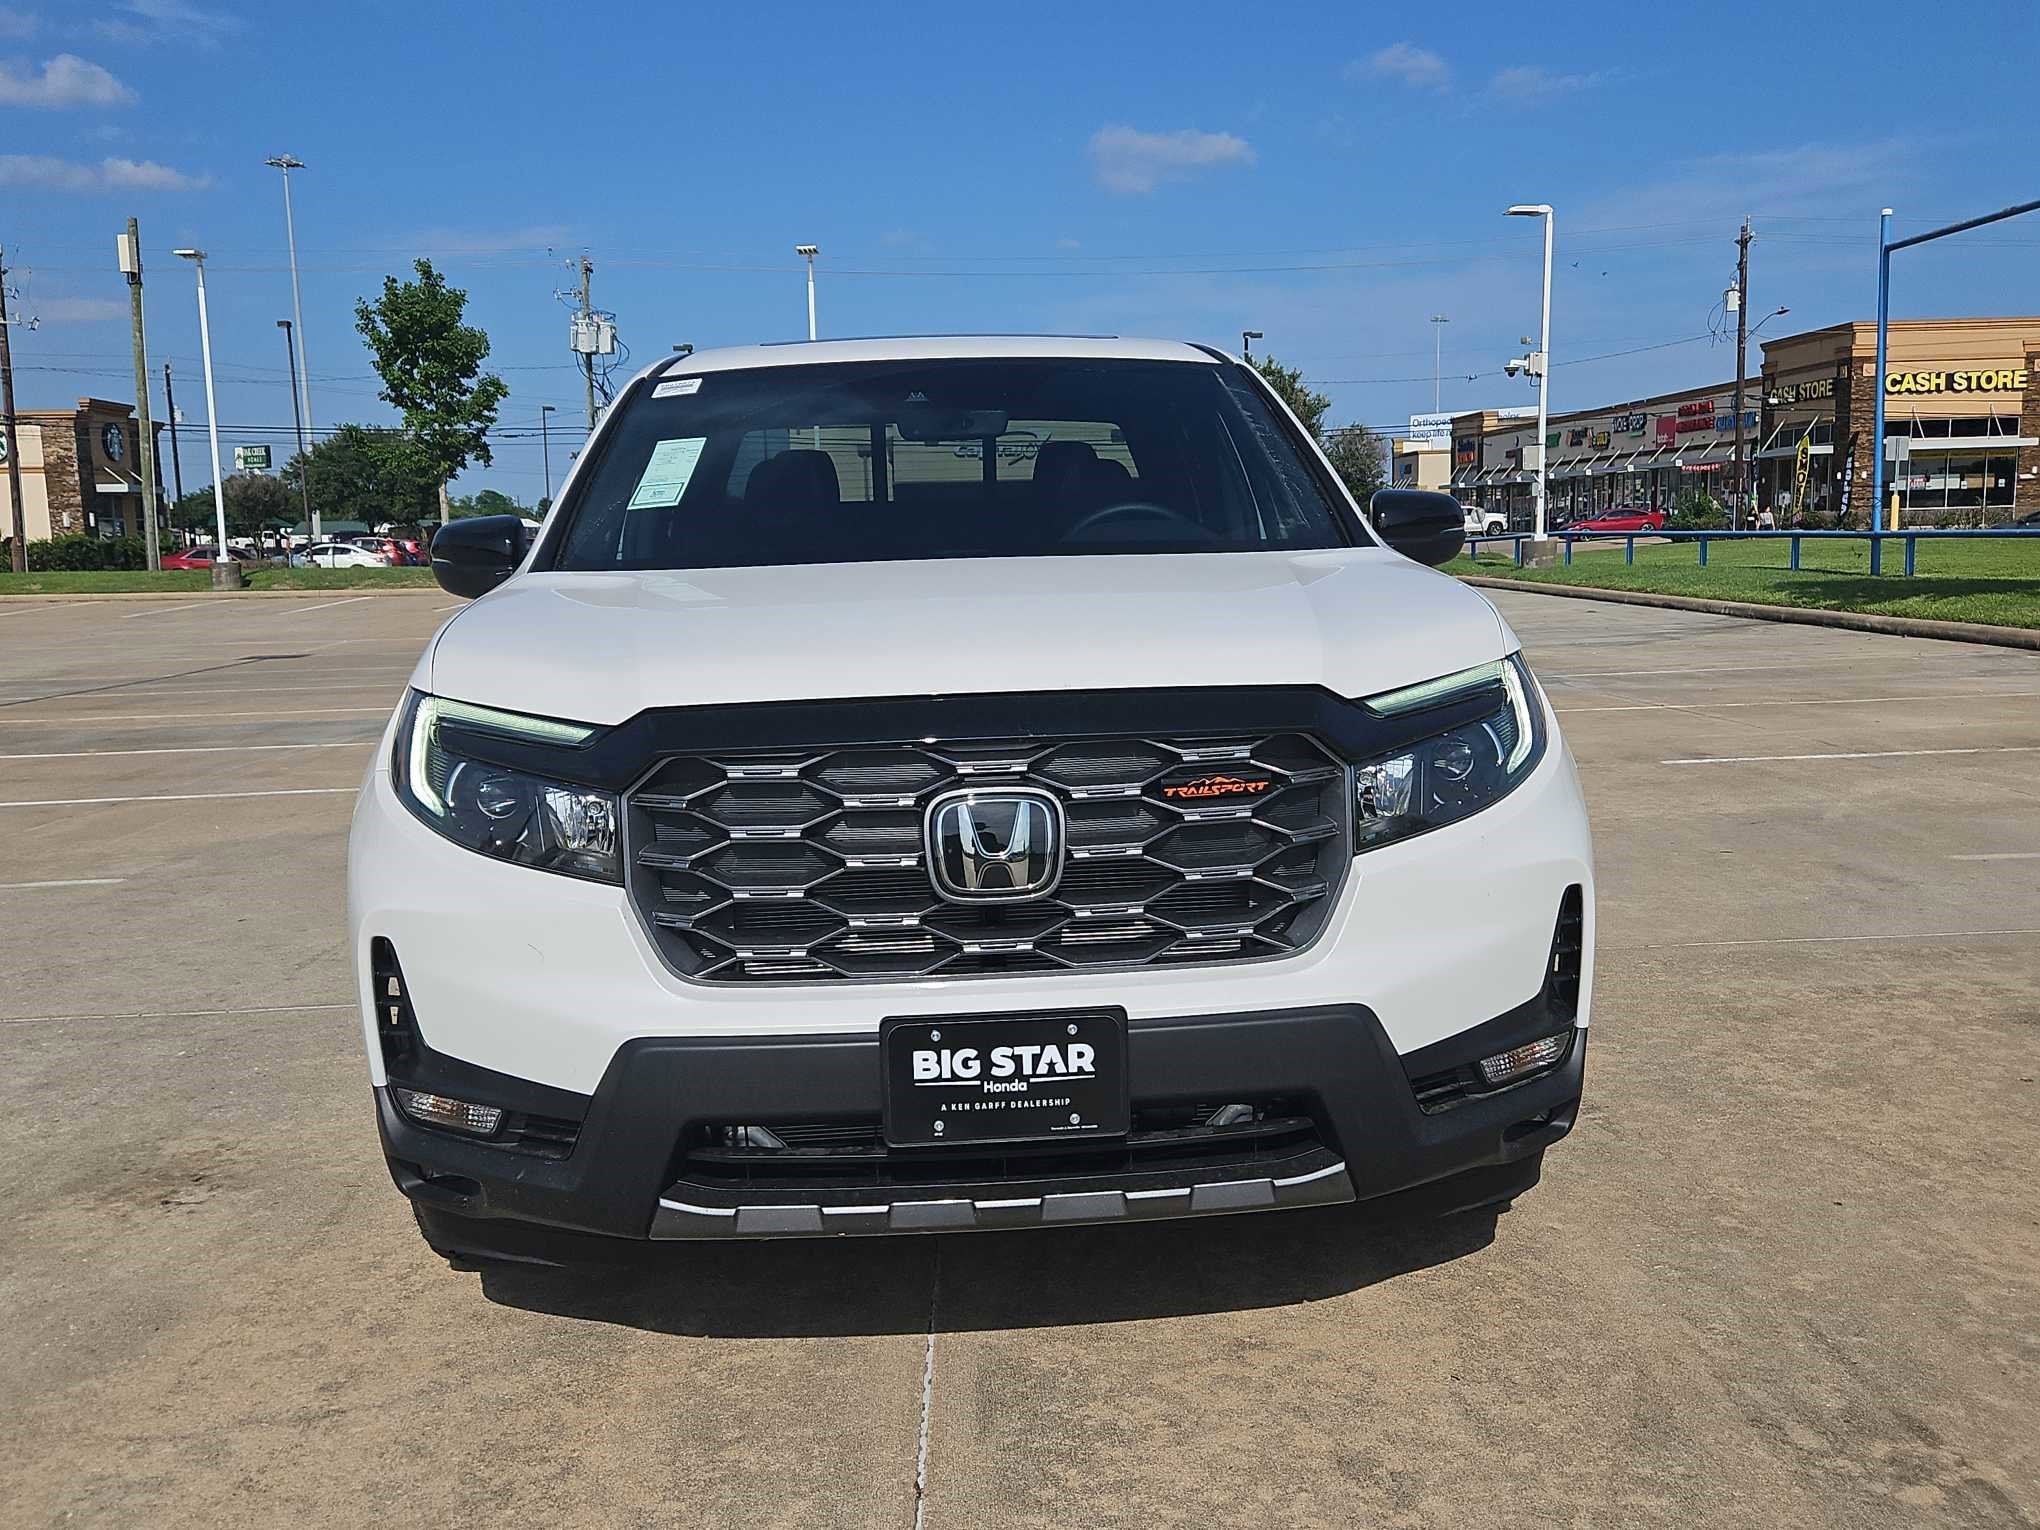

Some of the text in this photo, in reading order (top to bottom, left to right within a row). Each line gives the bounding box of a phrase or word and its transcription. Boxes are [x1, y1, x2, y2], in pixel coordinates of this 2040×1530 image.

[1885, 369, 2028, 393] CASH STORE
[1770, 379, 1833, 403] CASH STORE
[1412, 416, 1453, 427] Orthoped
[1163, 781, 1269, 798] TRAILSPORT
[912, 1043, 1096, 1080] BIG STAR
[983, 1078, 1028, 1093] Honda
[941, 1098, 1071, 1111] A KEN GARFF DEALERSHIP
